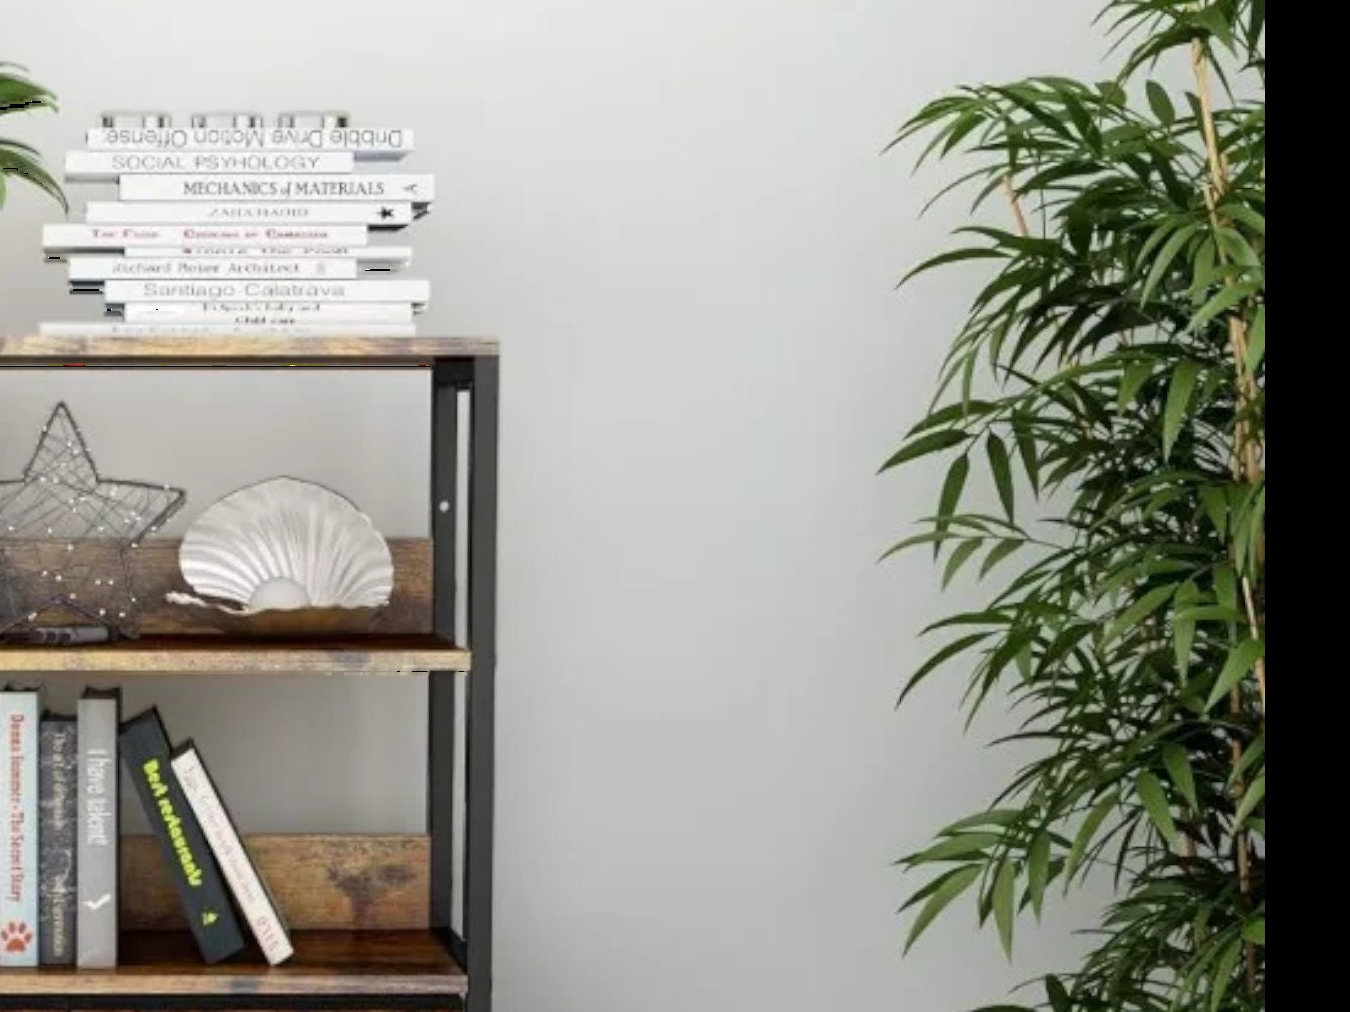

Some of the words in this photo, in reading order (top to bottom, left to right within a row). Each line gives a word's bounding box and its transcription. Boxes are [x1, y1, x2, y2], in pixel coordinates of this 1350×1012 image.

[193, 129, 264, 148] Motion
[272, 129, 323, 148] Drive
[330, 129, 402, 148] Dribble
[112, 155, 184, 170] SOCIAL
[183, 181, 278, 196] MECHANICS
[280, 181, 292, 200] of
[295, 181, 385, 196] MATERIALS
[228, 262, 299, 275] Architect
[143, 282, 234, 299] Santiago
[245, 282, 345, 297] Calatrava
[87, 757, 112, 795] have
